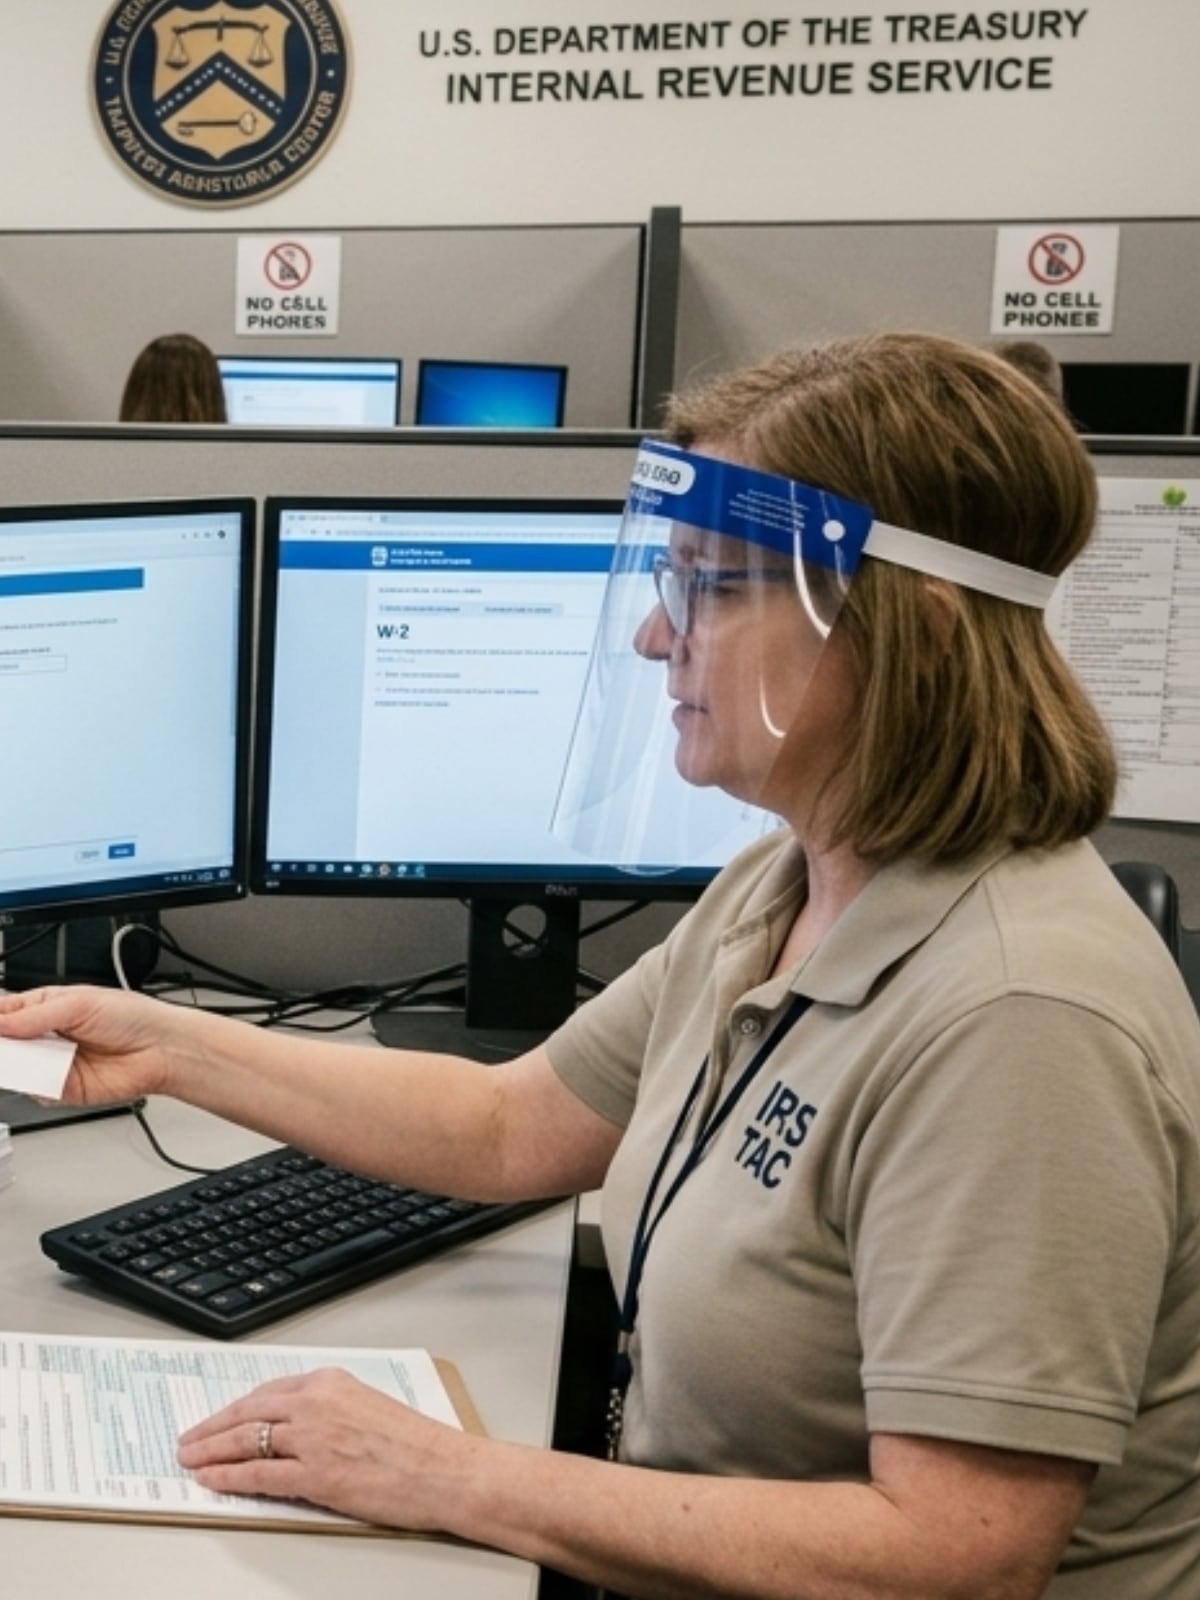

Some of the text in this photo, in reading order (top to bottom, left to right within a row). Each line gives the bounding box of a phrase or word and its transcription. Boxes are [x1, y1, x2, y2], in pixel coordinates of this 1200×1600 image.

[419, 9, 1088, 57] U.S. DEPARTMENT OF THE TREASURY
[447, 57, 1054, 104] INTERNAL REVENUE SERVICE
[246, 296, 274, 312] NO
[1004, 291, 1102, 308] NO CELL
[755, 1080, 818, 1147] IRS
[735, 1126, 792, 1189] TAC
